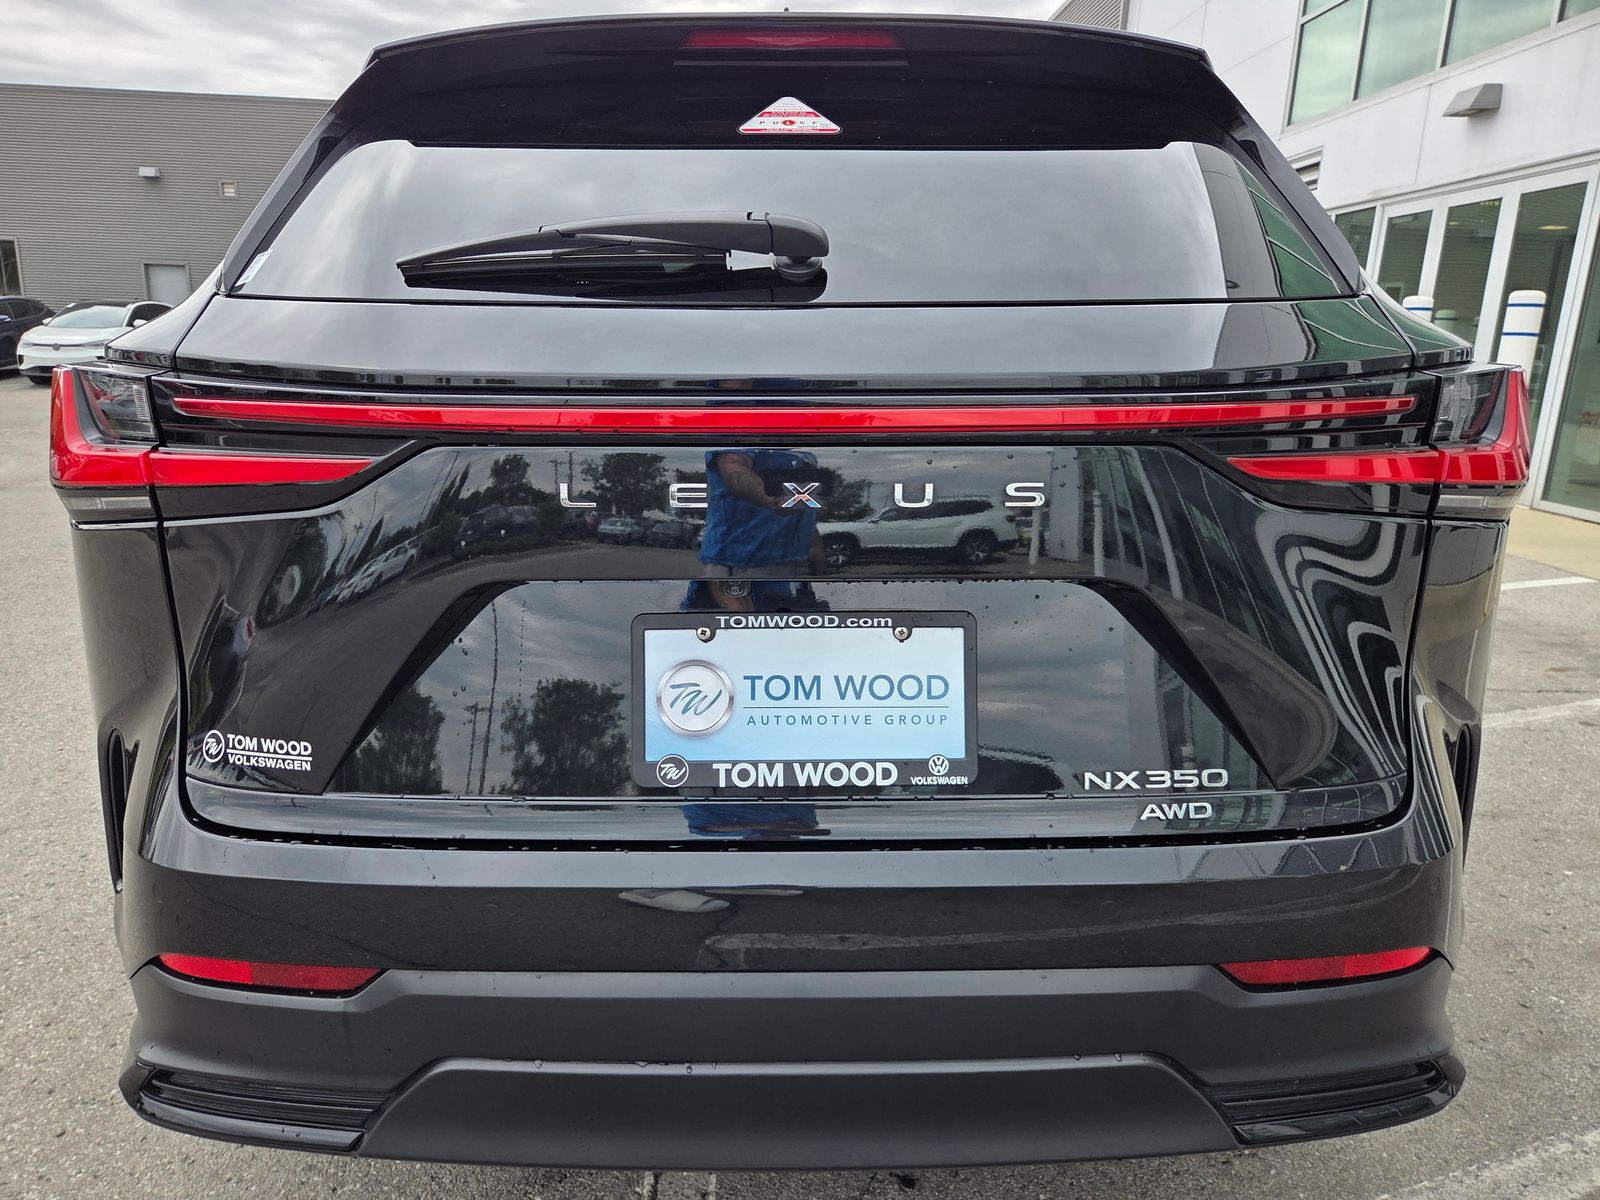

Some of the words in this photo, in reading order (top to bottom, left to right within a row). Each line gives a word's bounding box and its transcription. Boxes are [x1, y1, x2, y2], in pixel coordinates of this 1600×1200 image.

[559, 482, 1046, 509] LEXUS
[715, 615, 893, 628] TOMWOOD.com
[669, 682, 723, 717] TW
[743, 674, 822, 702] TOM
[833, 674, 950, 702] WOOD
[746, 714, 873, 726] AUTOMOTIVE
[884, 714, 949, 726] GROUP
[226, 733, 258, 752] TOM
[260, 737, 312, 756] WOOD
[227, 753, 312, 771] VOLKSWAGEN
[712, 762, 785, 788] TOM
[792, 761, 899, 787] WOOD
[910, 776, 969, 786] VOLKSWAGEN
[1083, 768, 1230, 791] NX350
[1139, 802, 1214, 821] AWD
